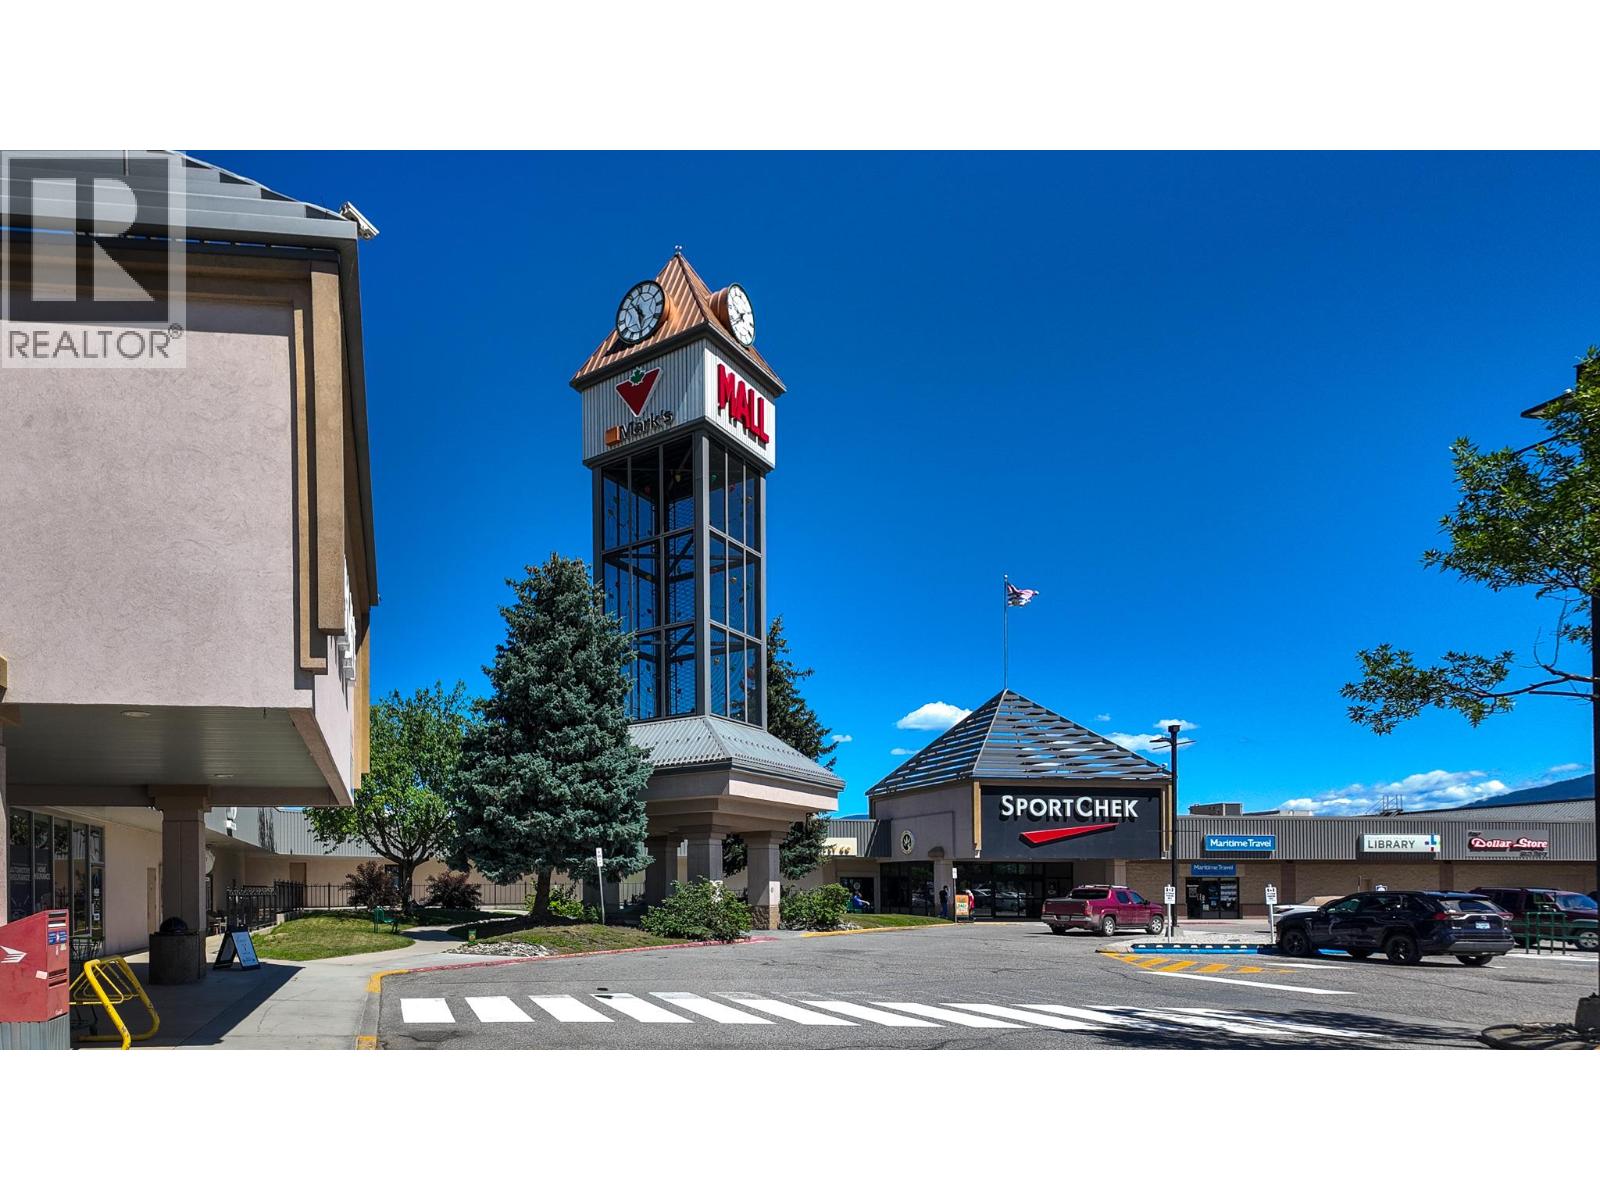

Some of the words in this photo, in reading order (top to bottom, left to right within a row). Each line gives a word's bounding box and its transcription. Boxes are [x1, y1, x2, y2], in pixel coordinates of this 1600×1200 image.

[717, 363, 769, 444] MALL
[620, 410, 673, 439] Mark's
[1210, 838, 1248, 848] Maritime
[1248, 838, 1272, 848] Travel
[1367, 840, 1416, 849] LIBRARY
[1471, 837, 1513, 848] Dollar
[1513, 837, 1548, 848] Store
